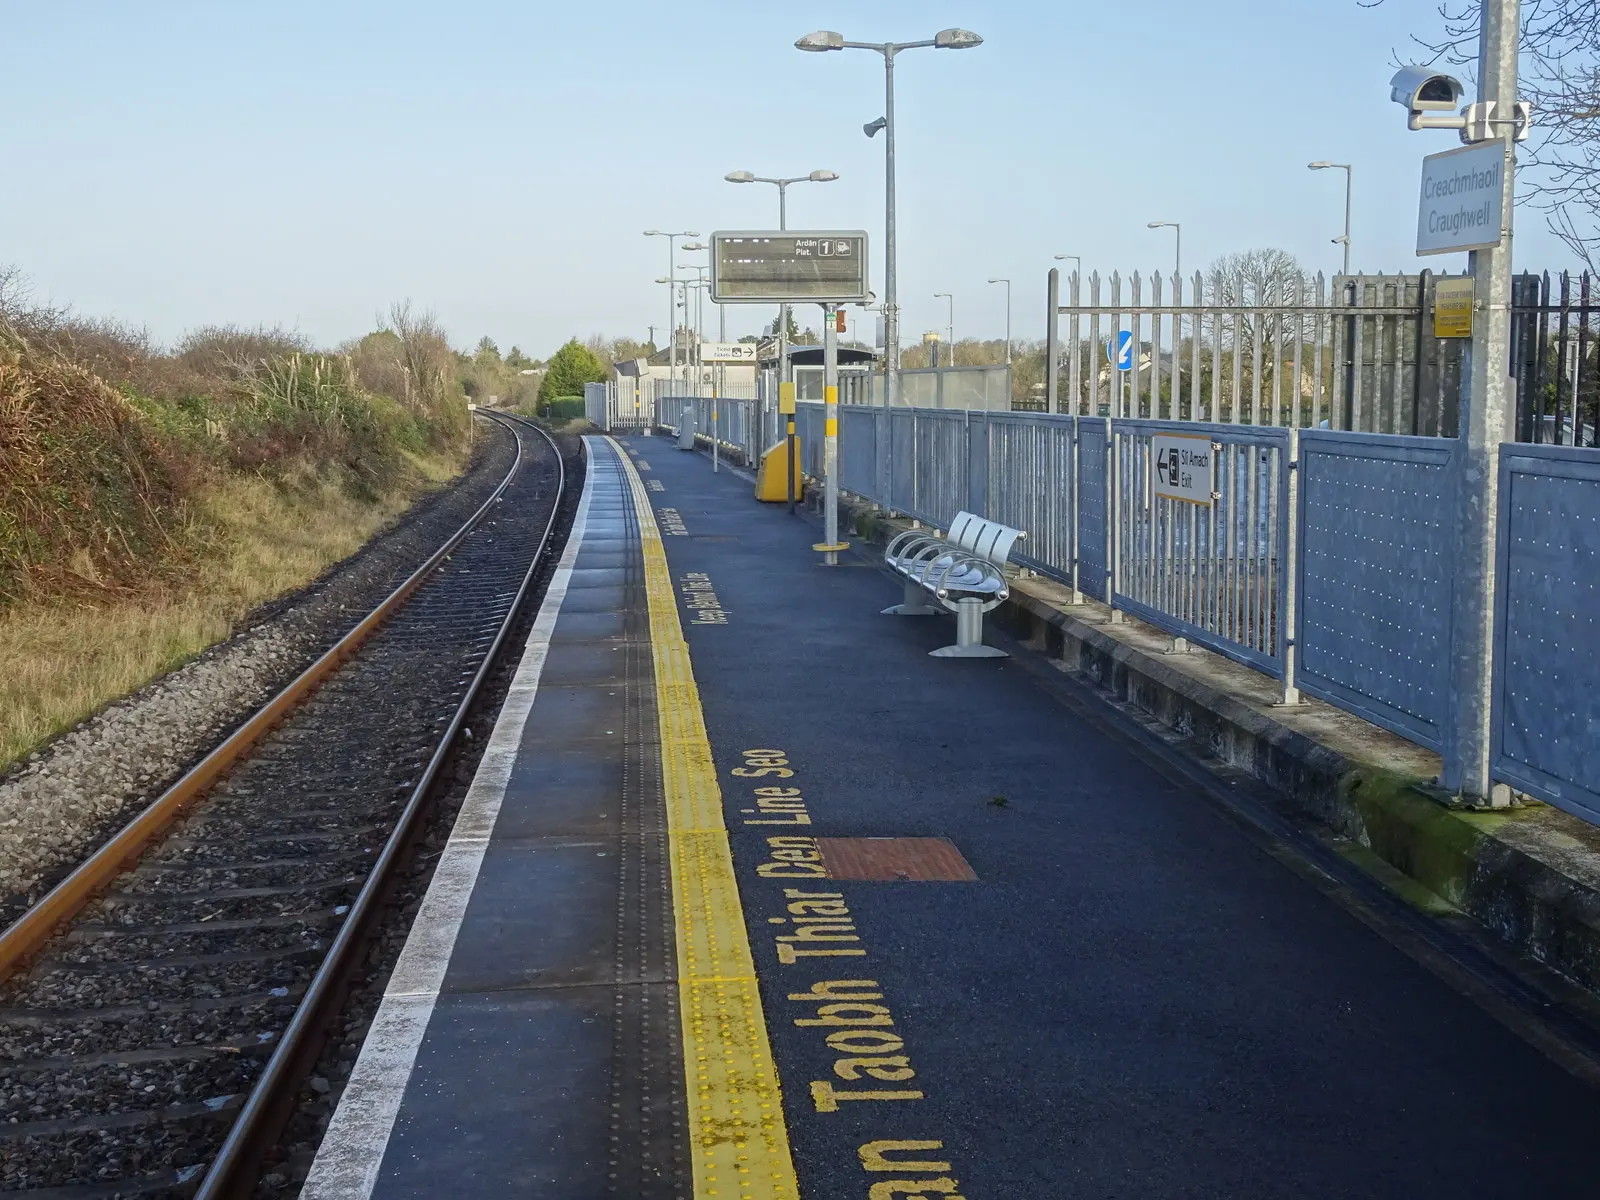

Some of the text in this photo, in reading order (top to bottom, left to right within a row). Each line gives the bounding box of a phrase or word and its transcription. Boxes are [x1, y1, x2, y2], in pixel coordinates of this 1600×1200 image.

[1424, 162, 1499, 199] Creachmhaoil
[1429, 201, 1490, 235] Craughwell
[796, 239, 829, 254] Ardán 1
[796, 248, 811, 256] Plat.
[1189, 450, 1209, 467] Amach
[1182, 472, 1192, 488] Exit
[731, 748, 794, 778] Seo
[756, 836, 832, 879] Den
[767, 888, 867, 964] Thiar
[787, 979, 925, 1113] Taobh
